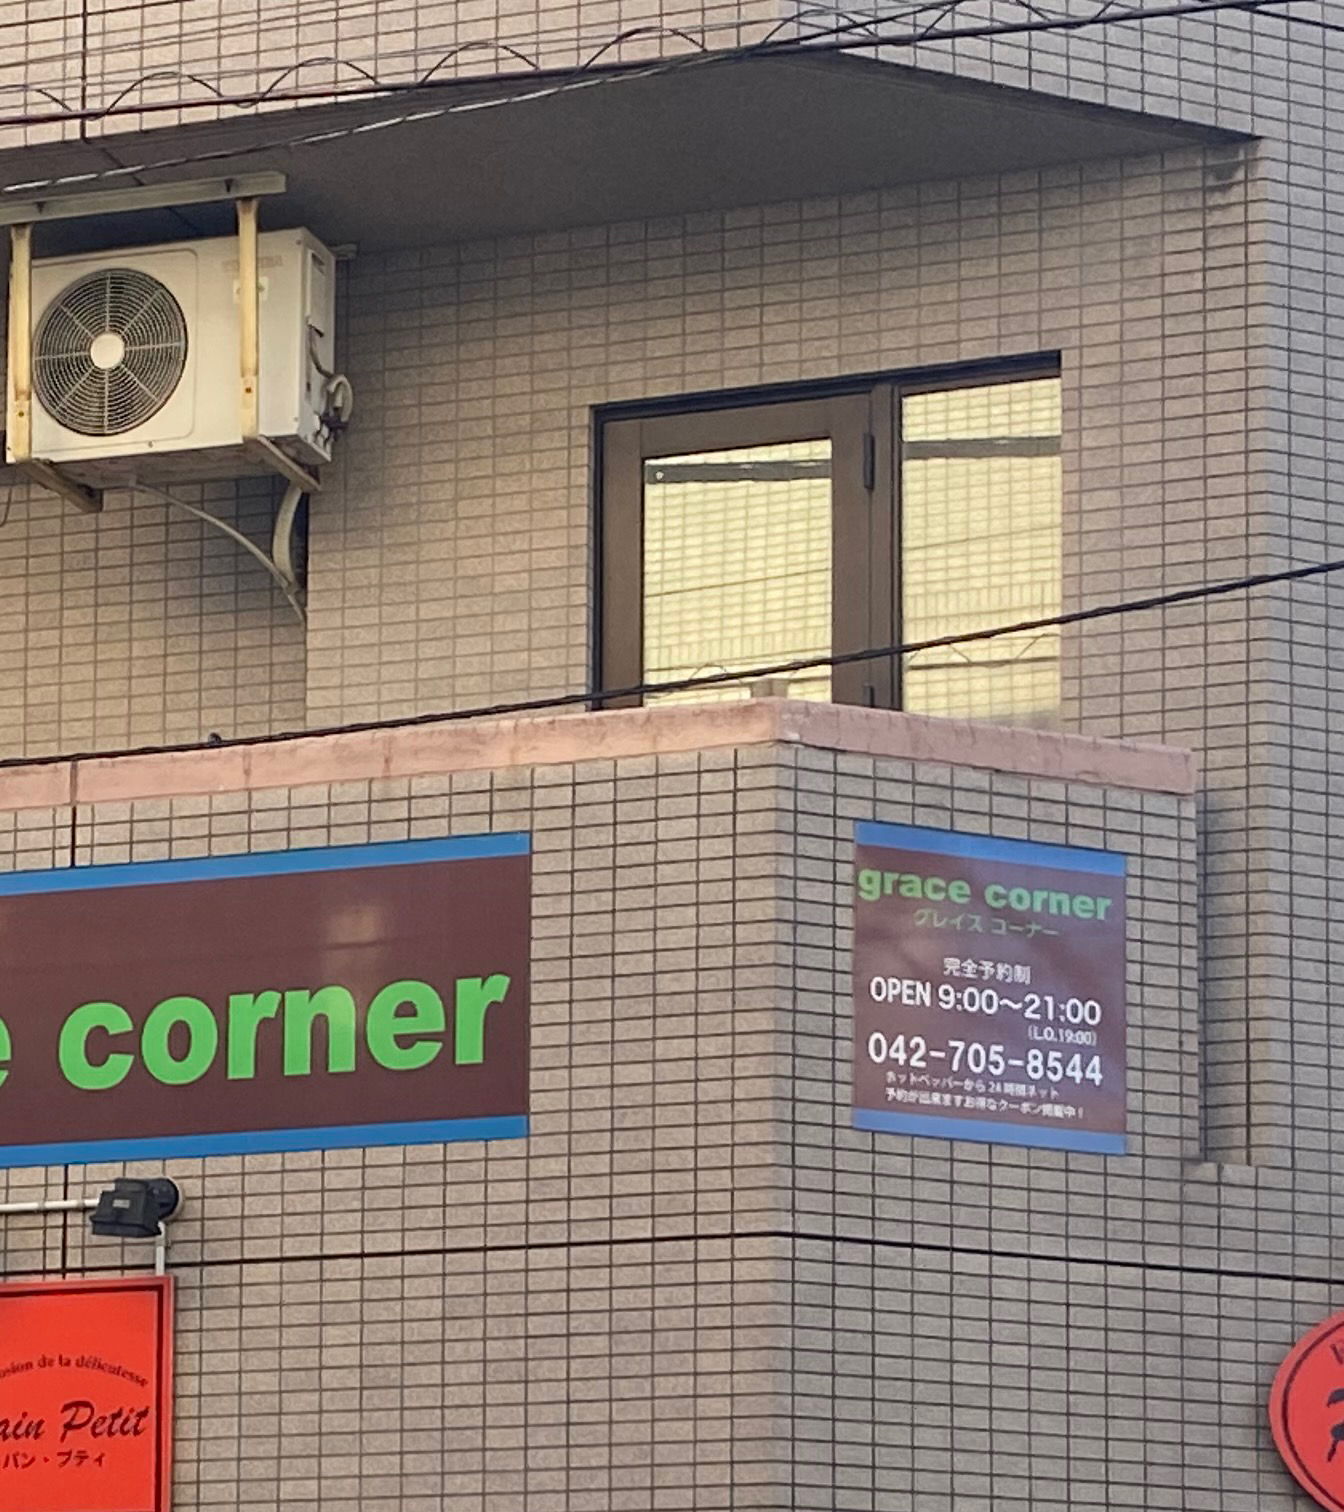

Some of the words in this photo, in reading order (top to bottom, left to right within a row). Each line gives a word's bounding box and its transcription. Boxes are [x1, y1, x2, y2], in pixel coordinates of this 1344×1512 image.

[858, 868, 971, 903] grace
[985, 884, 1112, 920] corner
[870, 976, 931, 1007] OPEN
[943, 957, 1031, 985] 完全予約制
[58, 973, 510, 1089] corner
[868, 1032, 1103, 1086] 042-705-8544
[38, 1354, 54, 1368] de
[58, 1353, 71, 1368] la
[60, 1401, 149, 1443] Petit
